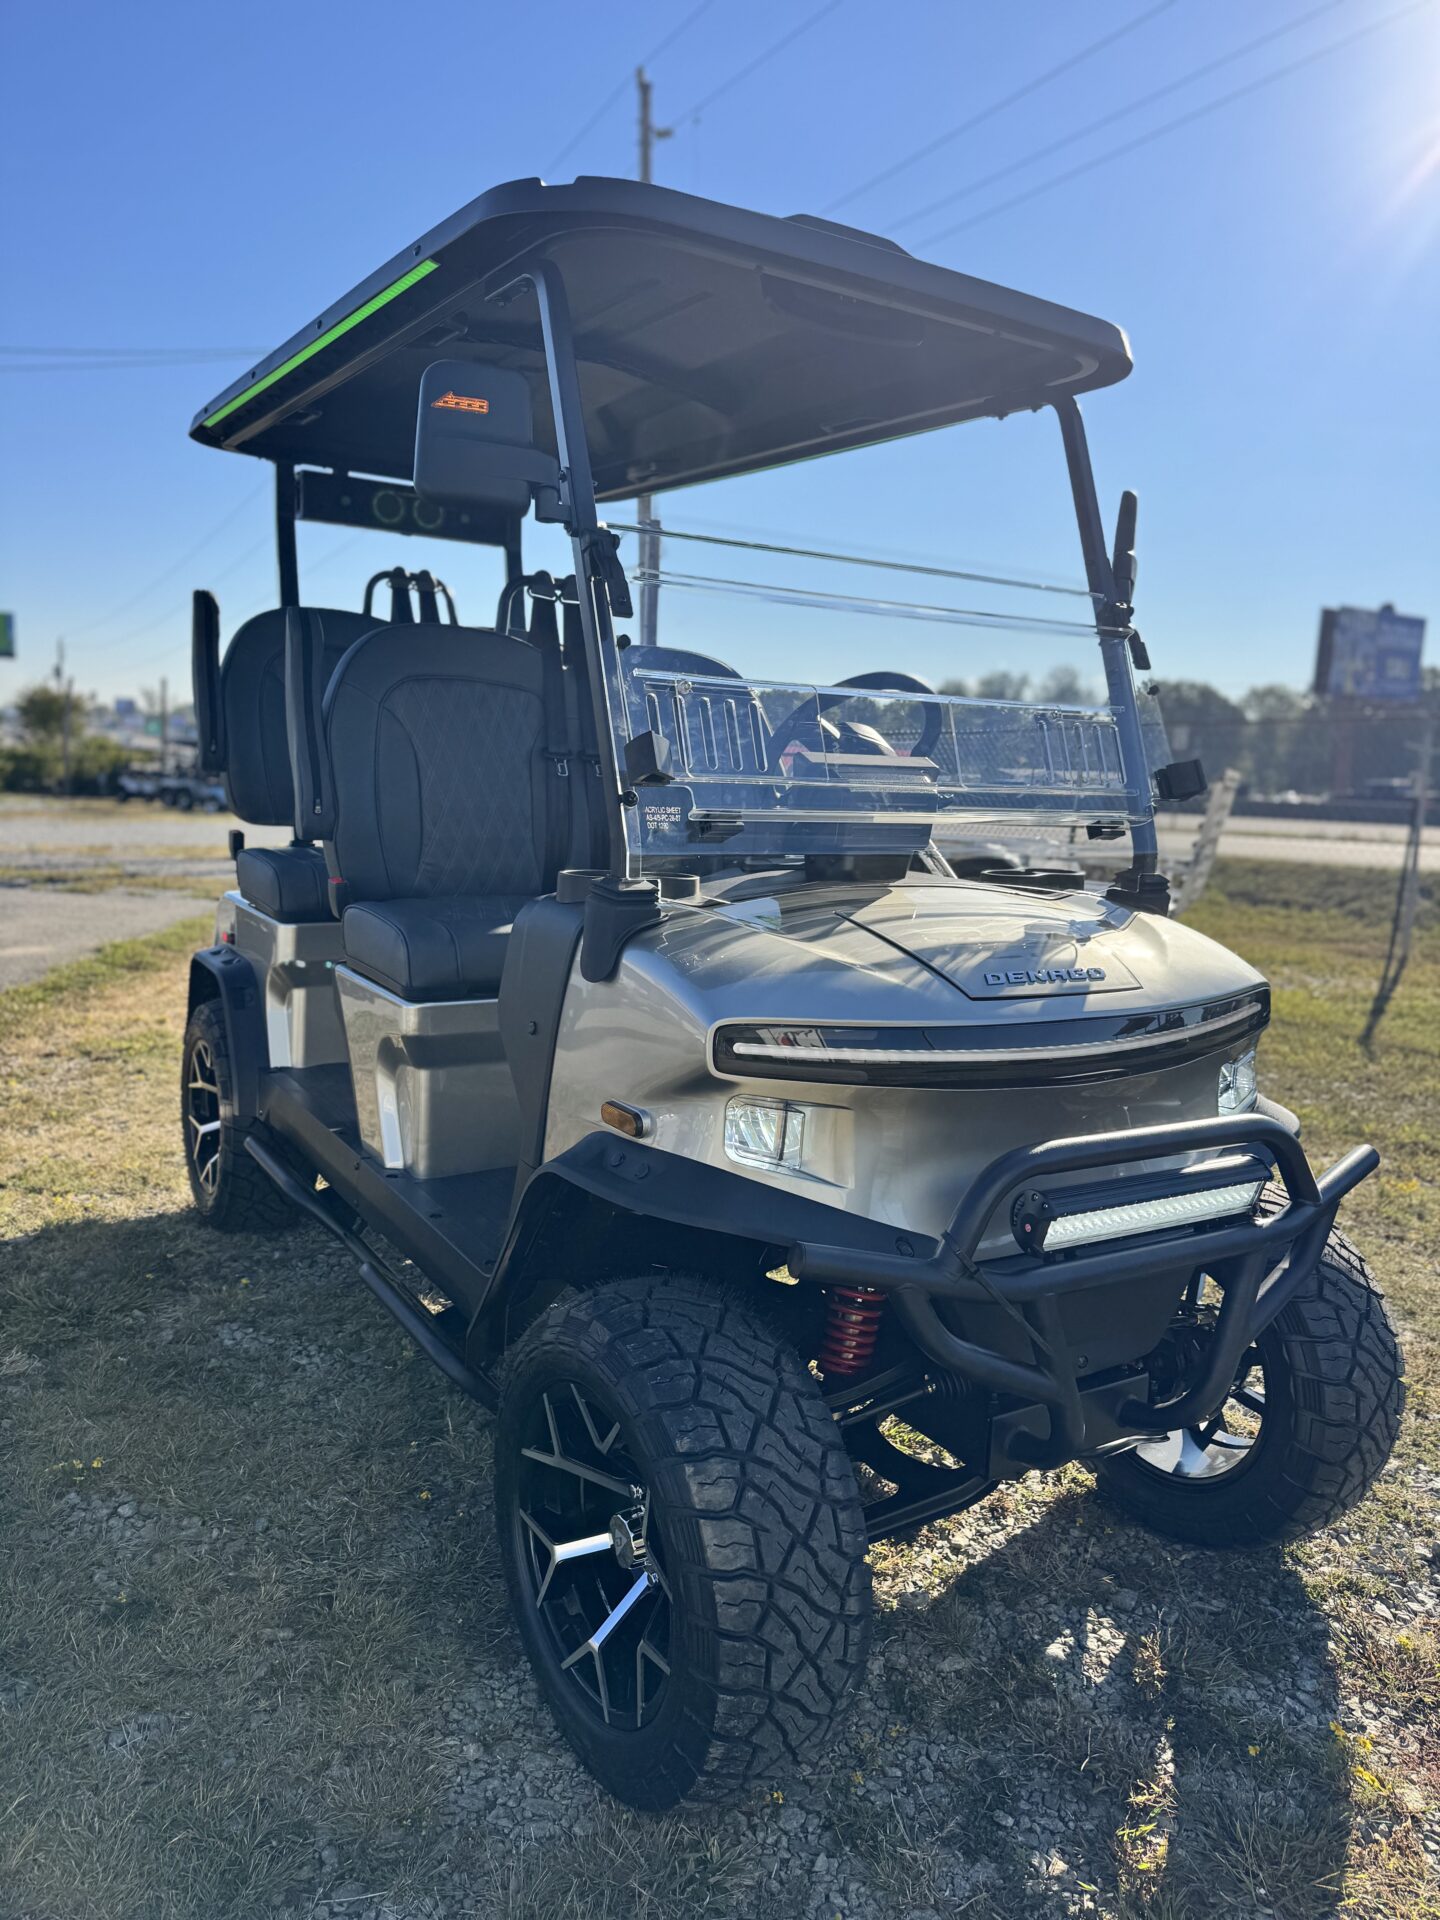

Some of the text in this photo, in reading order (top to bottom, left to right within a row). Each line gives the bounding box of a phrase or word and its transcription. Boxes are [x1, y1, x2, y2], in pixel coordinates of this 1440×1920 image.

[645, 806, 681, 814] ACRYLIC SHEET
[647, 822, 657, 830] DOT
[984, 967, 1107, 987] DENAGO
